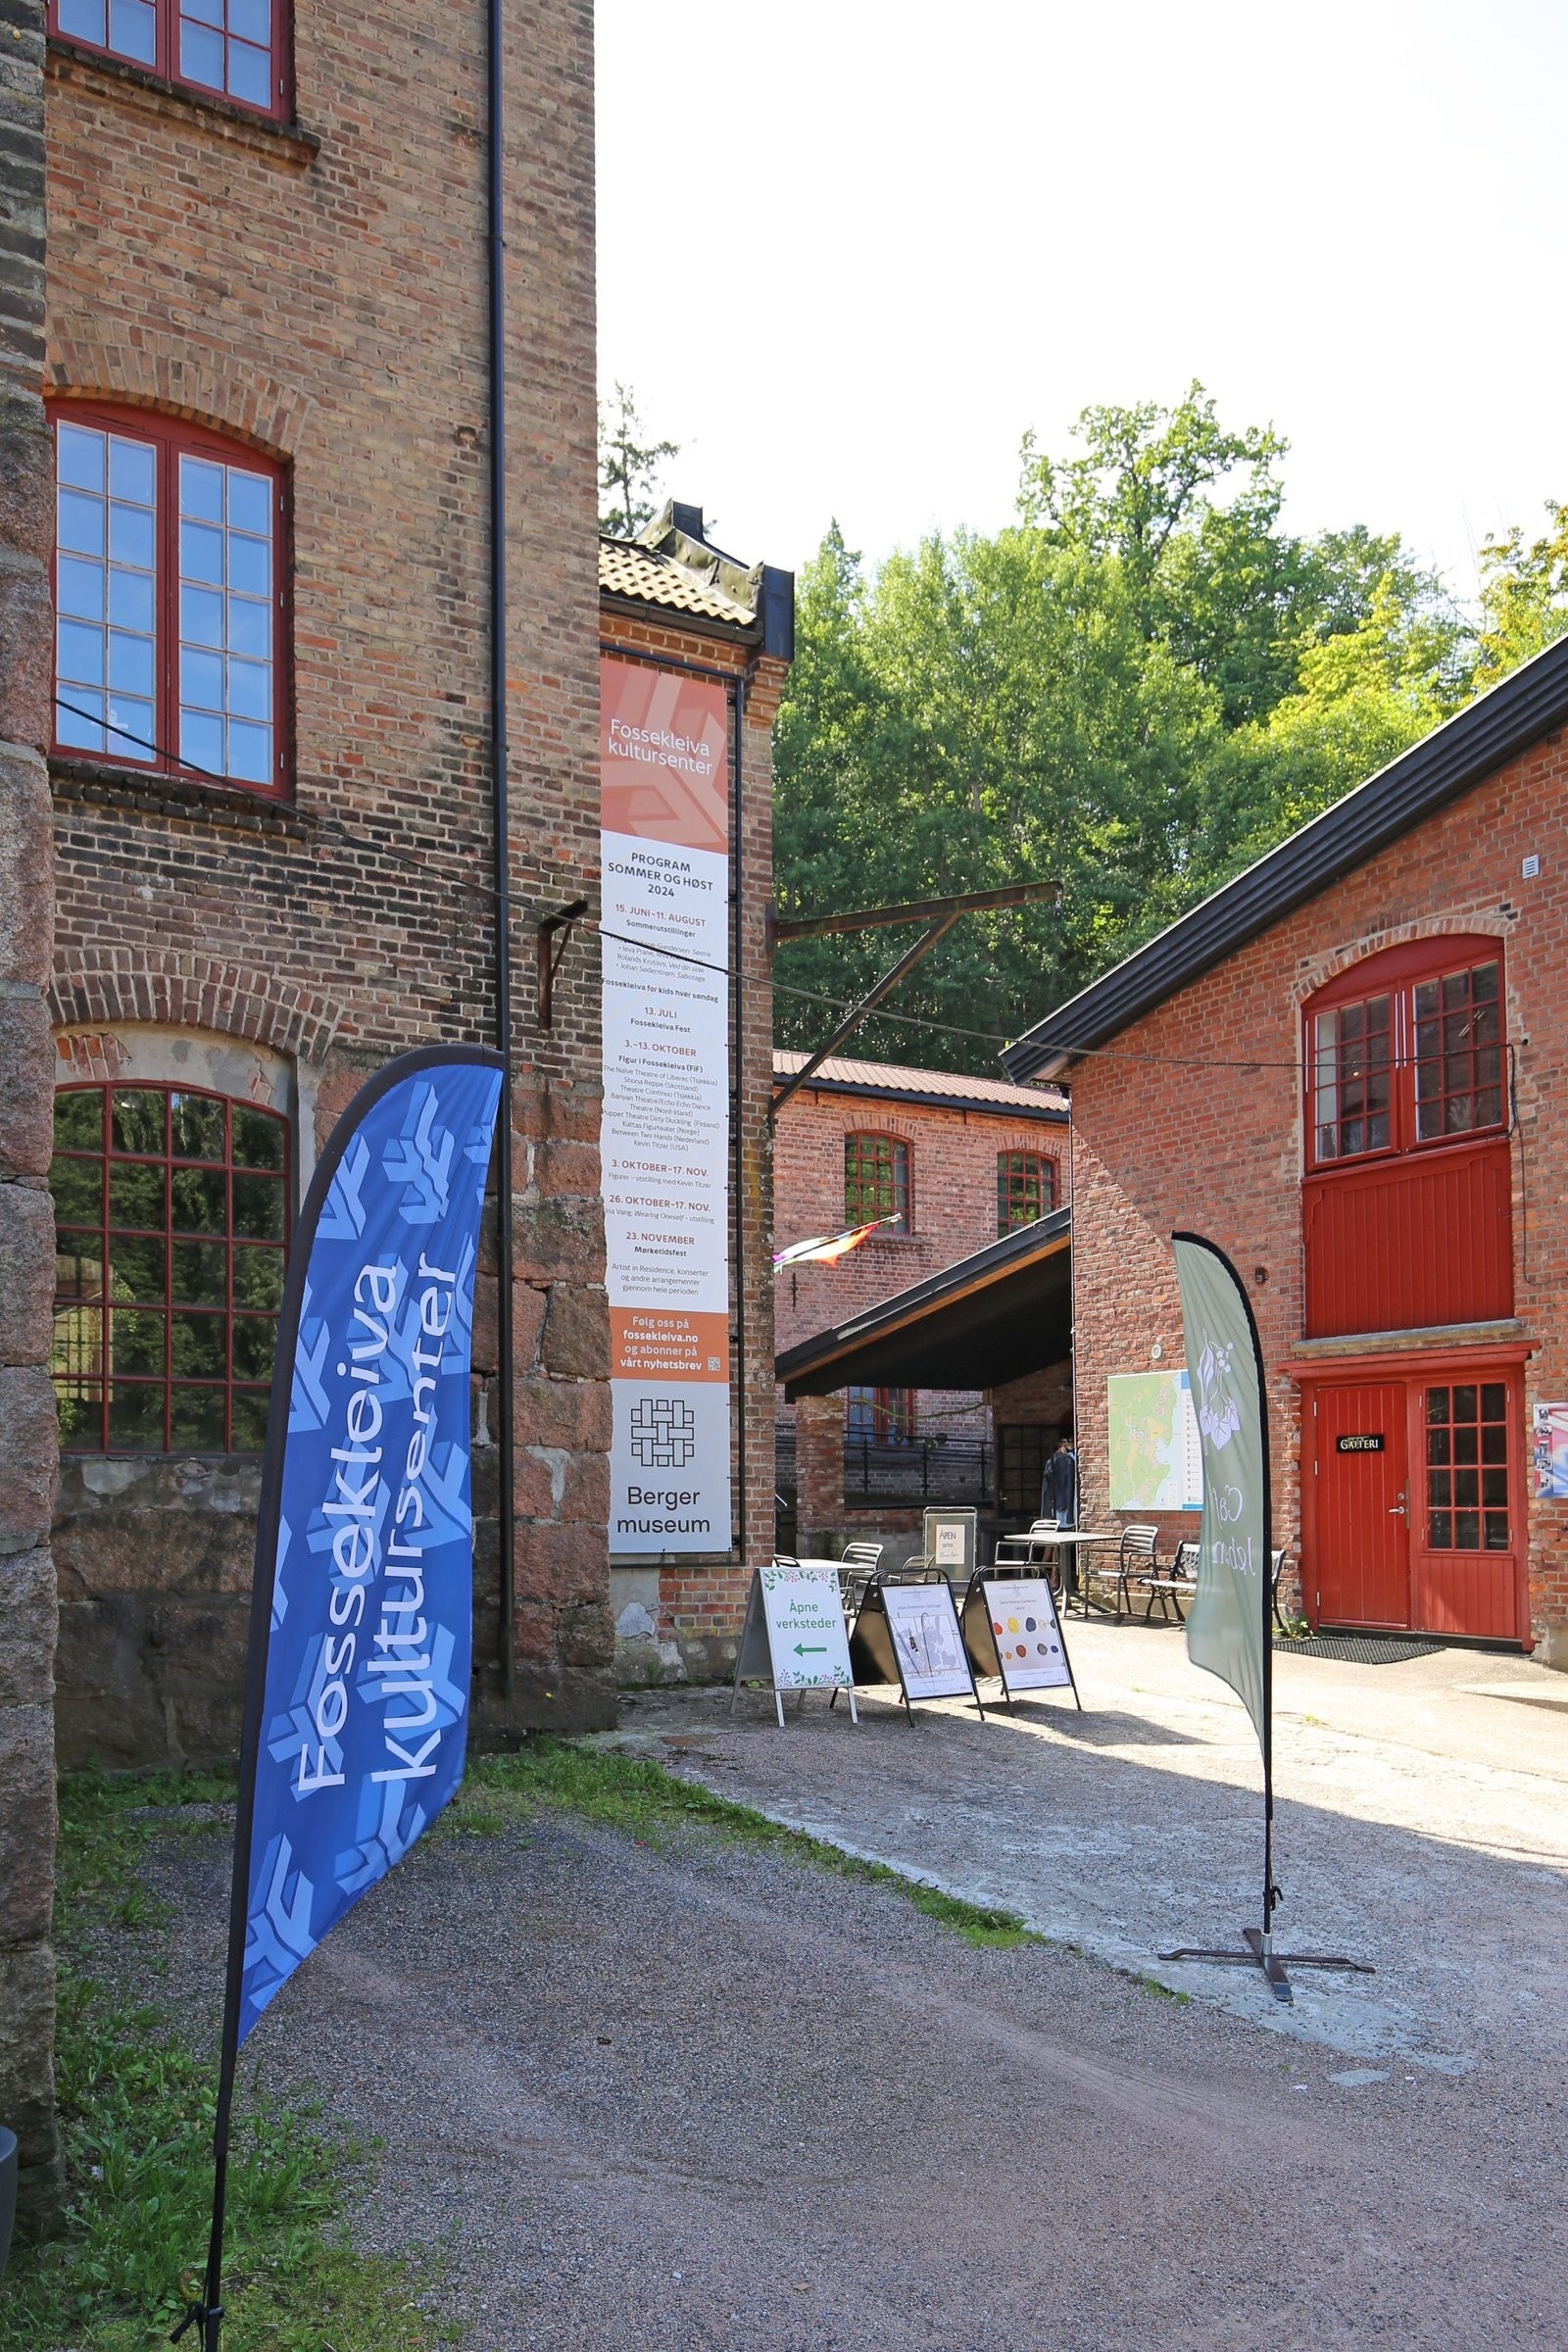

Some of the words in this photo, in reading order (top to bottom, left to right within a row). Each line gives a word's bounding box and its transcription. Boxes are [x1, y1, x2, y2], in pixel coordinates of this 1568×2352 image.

[611, 718, 710, 757] Fossekleiva
[609, 737, 712, 775] kultursenter
[631, 853, 690, 872] PROGRAM
[608, 862, 661, 881] SOMMER
[663, 873, 680, 884] OG
[683, 877, 712, 891] HØST
[648, 884, 674, 897] 2024
[615, 904, 626, 912] 15.
[668, 913, 706, 927] AUGUST
[626, 919, 695, 938] Sommerutstillinger
[617, 954, 642, 963] Rolands
[669, 961, 680, 970] Ved
[620, 962, 638, 971] Johan
[677, 969, 706, 982] Sabotage
[602, 977, 646, 991] Fossekleiva
[659, 986, 674, 995] kids
[693, 992, 718, 1004] søndag
[645, 1007, 656, 1016] 13.
[658, 1009, 677, 1018] JULI
[630, 1018, 673, 1031] Fossekleiva
[652, 1044, 697, 1056] OKTOBER
[618, 1055, 637, 1064] Figur
[642, 1059, 685, 1070] Fossekleiva
[687, 1064, 703, 1073] (FiF)
[635, 1069, 658, 1078] Theatre
[620, 1085, 644, 1094] Theatre
[645, 1088, 672, 1098] Continuo
[644, 1079, 663, 1088] Reppe
[665, 1081, 699, 1093] (Skottland)
[611, 1093, 633, 1102] Banyan
[635, 1095, 675, 1106] Theatre/Echo
[676, 1100, 691, 1108] Echo
[630, 1103, 653, 1112] Theatre
[603, 1109, 624, 1118] Puppet
[625, 1112, 649, 1121] Theatre
[693, 1119, 720, 1129] (Finland)
[643, 1123, 675, 1133] Figurteater
[677, 1127, 700, 1136] (Norge)
[612, 1128, 639, 1137] Between
[674, 1135, 710, 1146] (Nederland)
[612, 1159, 620, 1168] 3.
[686, 1167, 709, 1177] NOV.
[609, 1172, 629, 1181] Figurer
[636, 1175, 662, 1185] utstilling
[610, 1195, 623, 1203] 26.
[688, 1202, 710, 1211] NOV.
[635, 1209, 659, 1219] Wearing
[689, 1215, 714, 1224] utstilling
[626, 1232, 639, 1241] 23.
[641, 1233, 695, 1245] NOVEMBER
[635, 1247, 687, 1256] Mørketidsfest
[640, 1265, 675, 1275] Residence,
[652, 1277, 700, 1286] arrangementer
[633, 1316, 655, 1328] Følg
[677, 1318, 689, 1330] på
[623, 1330, 698, 1343] fossekleiva.no
[624, 1346, 638, 1354] og
[640, 1345, 682, 1355] abonner
[685, 1347, 697, 1357] på
[620, 1357, 642, 1367] vårt
[644, 1359, 702, 1370] nyhetsbrev
[1341, 1440, 1379, 1449] GALLERI
[628, 1486, 700, 1510] Berger
[368, 1252, 456, 1784] kultursenter
[297, 1263, 398, 1791] Fossekleiva
[617, 1519, 710, 1533] museum
[940, 1529, 956, 1540] ÅPEN
[790, 1598, 818, 1614] Åpne
[776, 1617, 836, 1629] verksteder
